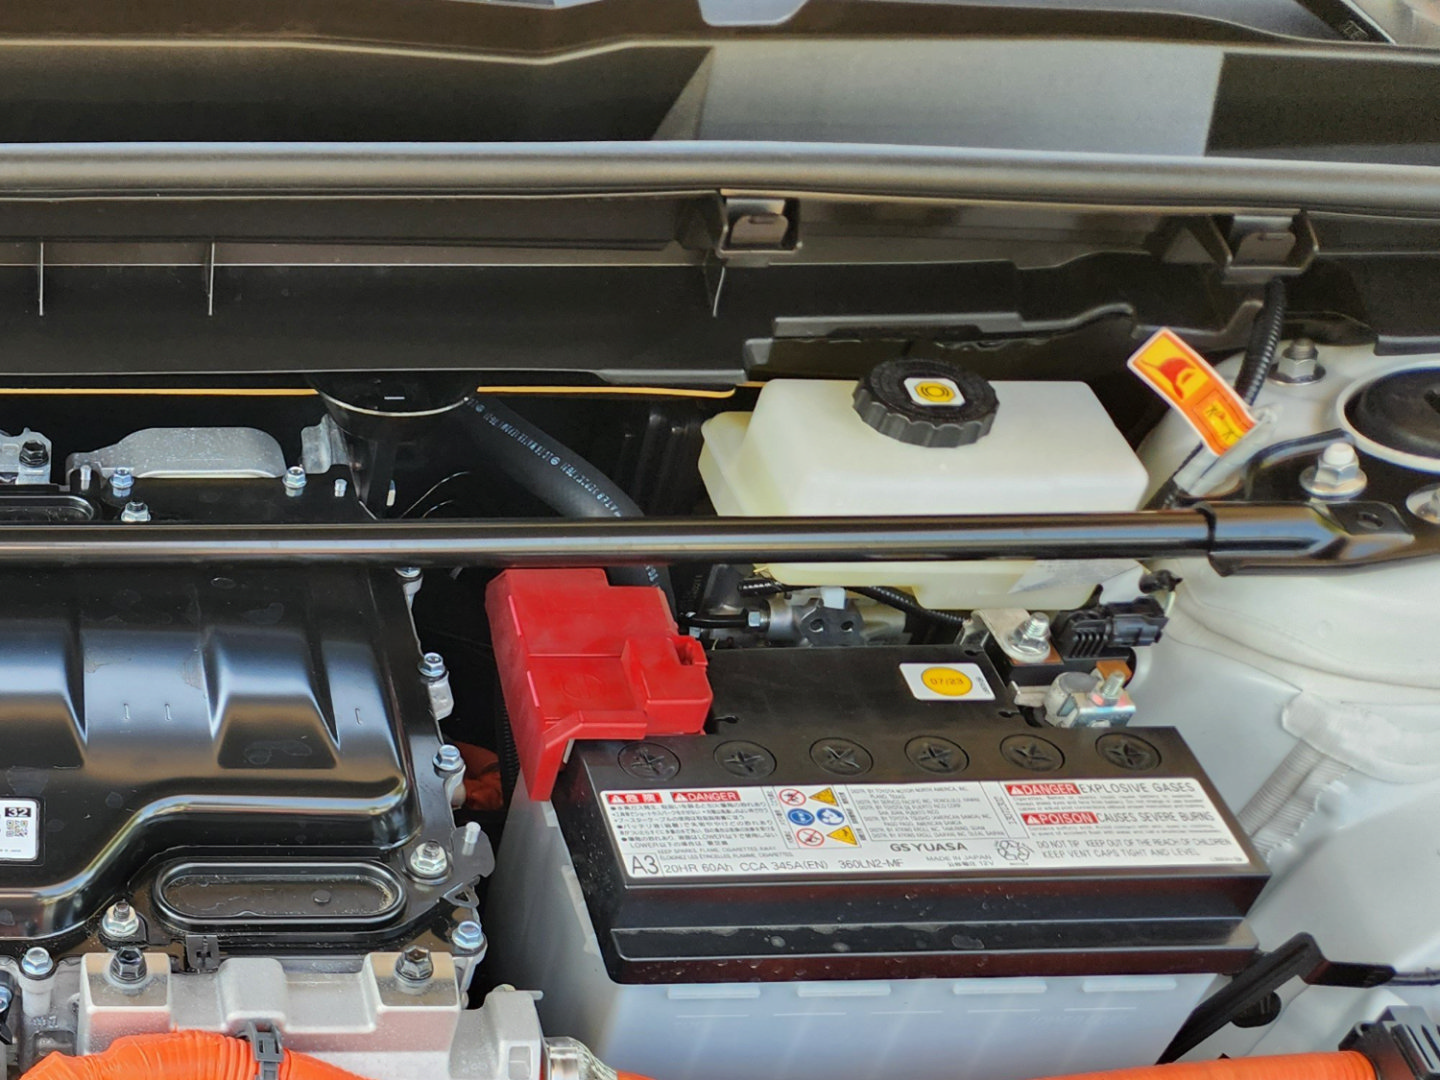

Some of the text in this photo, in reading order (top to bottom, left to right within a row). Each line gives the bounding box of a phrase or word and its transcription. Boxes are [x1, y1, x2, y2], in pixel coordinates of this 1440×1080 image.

[1022, 782, 1196, 795] DANGER EXPLOSIVE GASES
[624, 793, 656, 803] 危険
[687, 792, 737, 801] DANGER
[8, 808, 28, 817] 32
[1039, 811, 1215, 824] POISON CAUSES SEVERE BURNS
[888, 841, 968, 852] GS YUASA
[1036, 840, 1049, 848] DO
[1050, 840, 1066, 848] NOT
[1068, 839, 1080, 847] TIP
[1085, 839, 1105, 847] KEEP
[1106, 839, 1122, 847] OUT
[1134, 838, 1152, 846] THE
[1152, 838, 1178, 846] REACH
[1180, 838, 1190, 846] OF
[1192, 838, 1232, 846] CHILDREN
[1042, 848, 1200, 858] KEEP VENT CAPS TIGHT AND LEVEL
[632, 854, 904, 874] A3 20HR 60Ah CCA 345A(EN) 360LN2-MF
